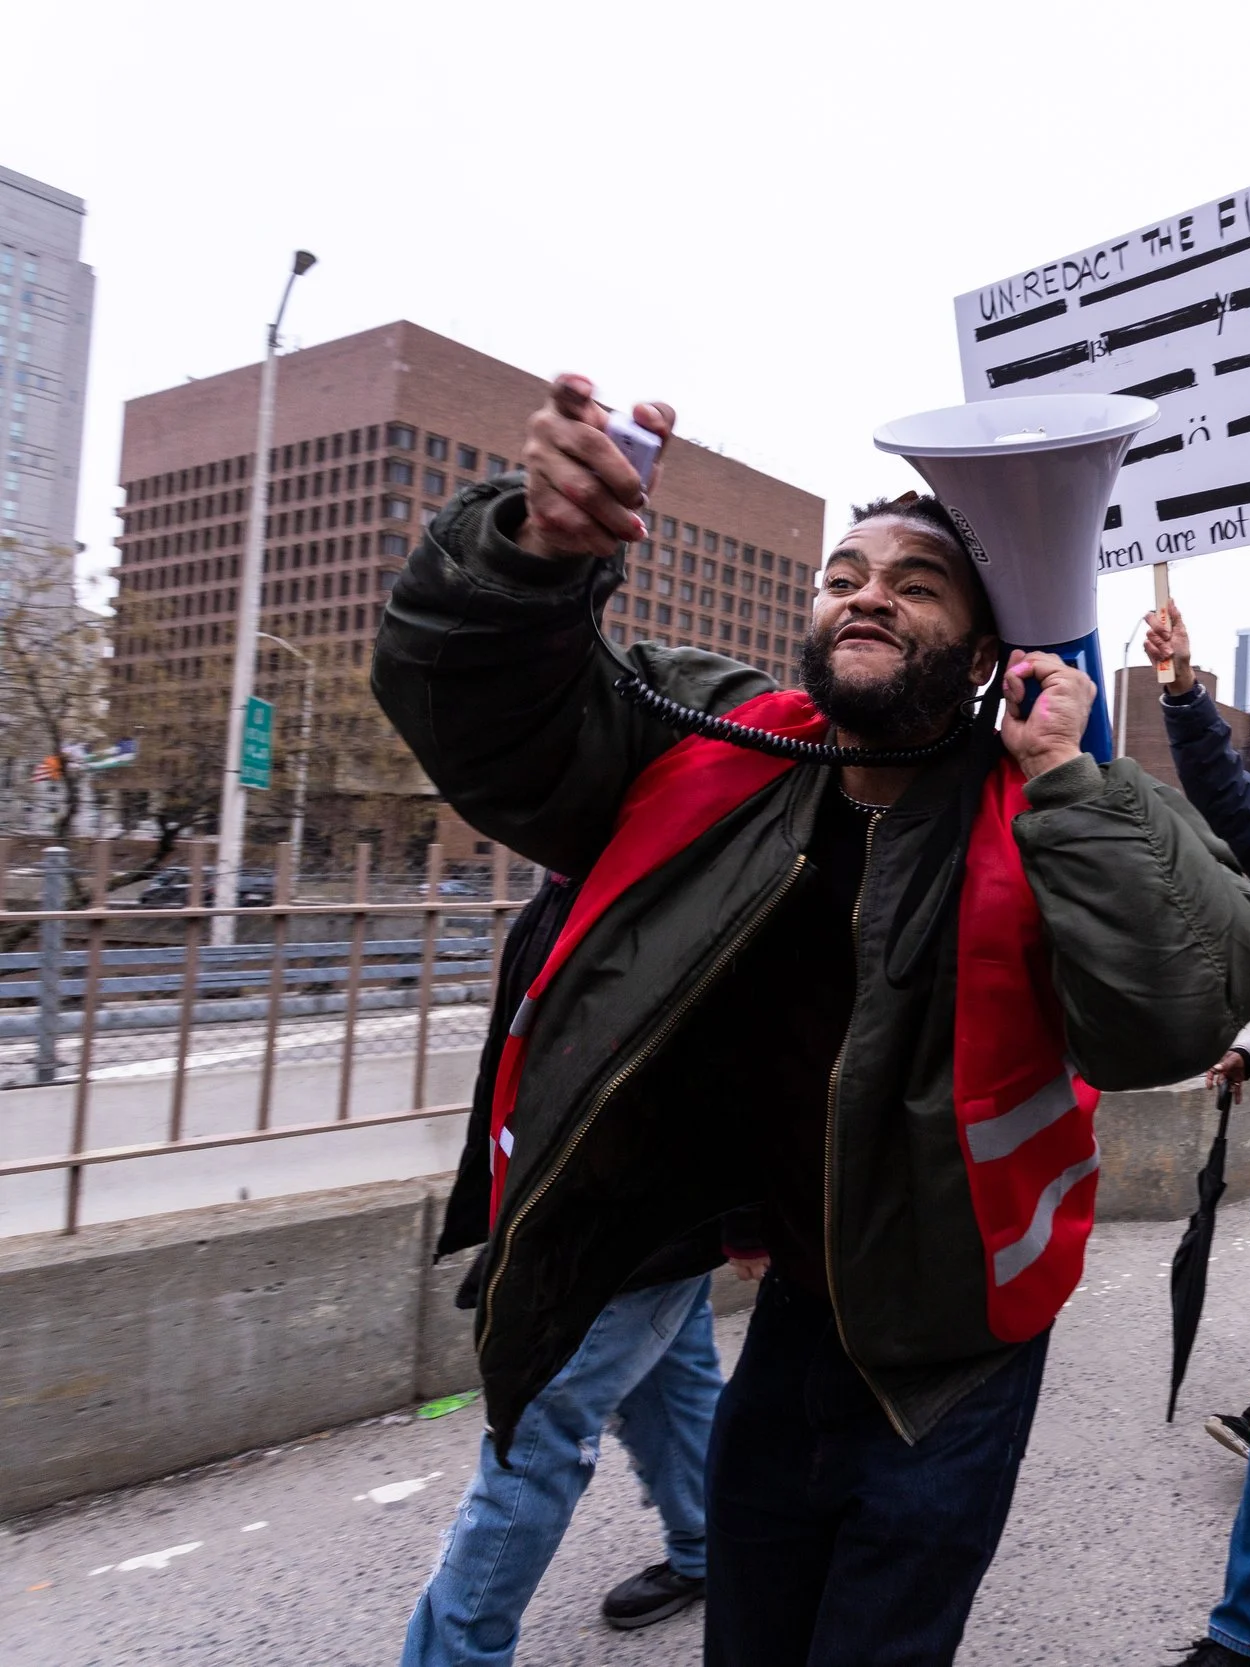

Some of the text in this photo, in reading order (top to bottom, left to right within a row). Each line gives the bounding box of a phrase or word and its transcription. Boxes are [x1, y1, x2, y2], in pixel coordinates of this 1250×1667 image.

[980, 240, 1129, 322] UN-REDACT
[1141, 215, 1195, 257] THE
[1156, 528, 1196, 554] are
[1210, 506, 1250, 545] not
